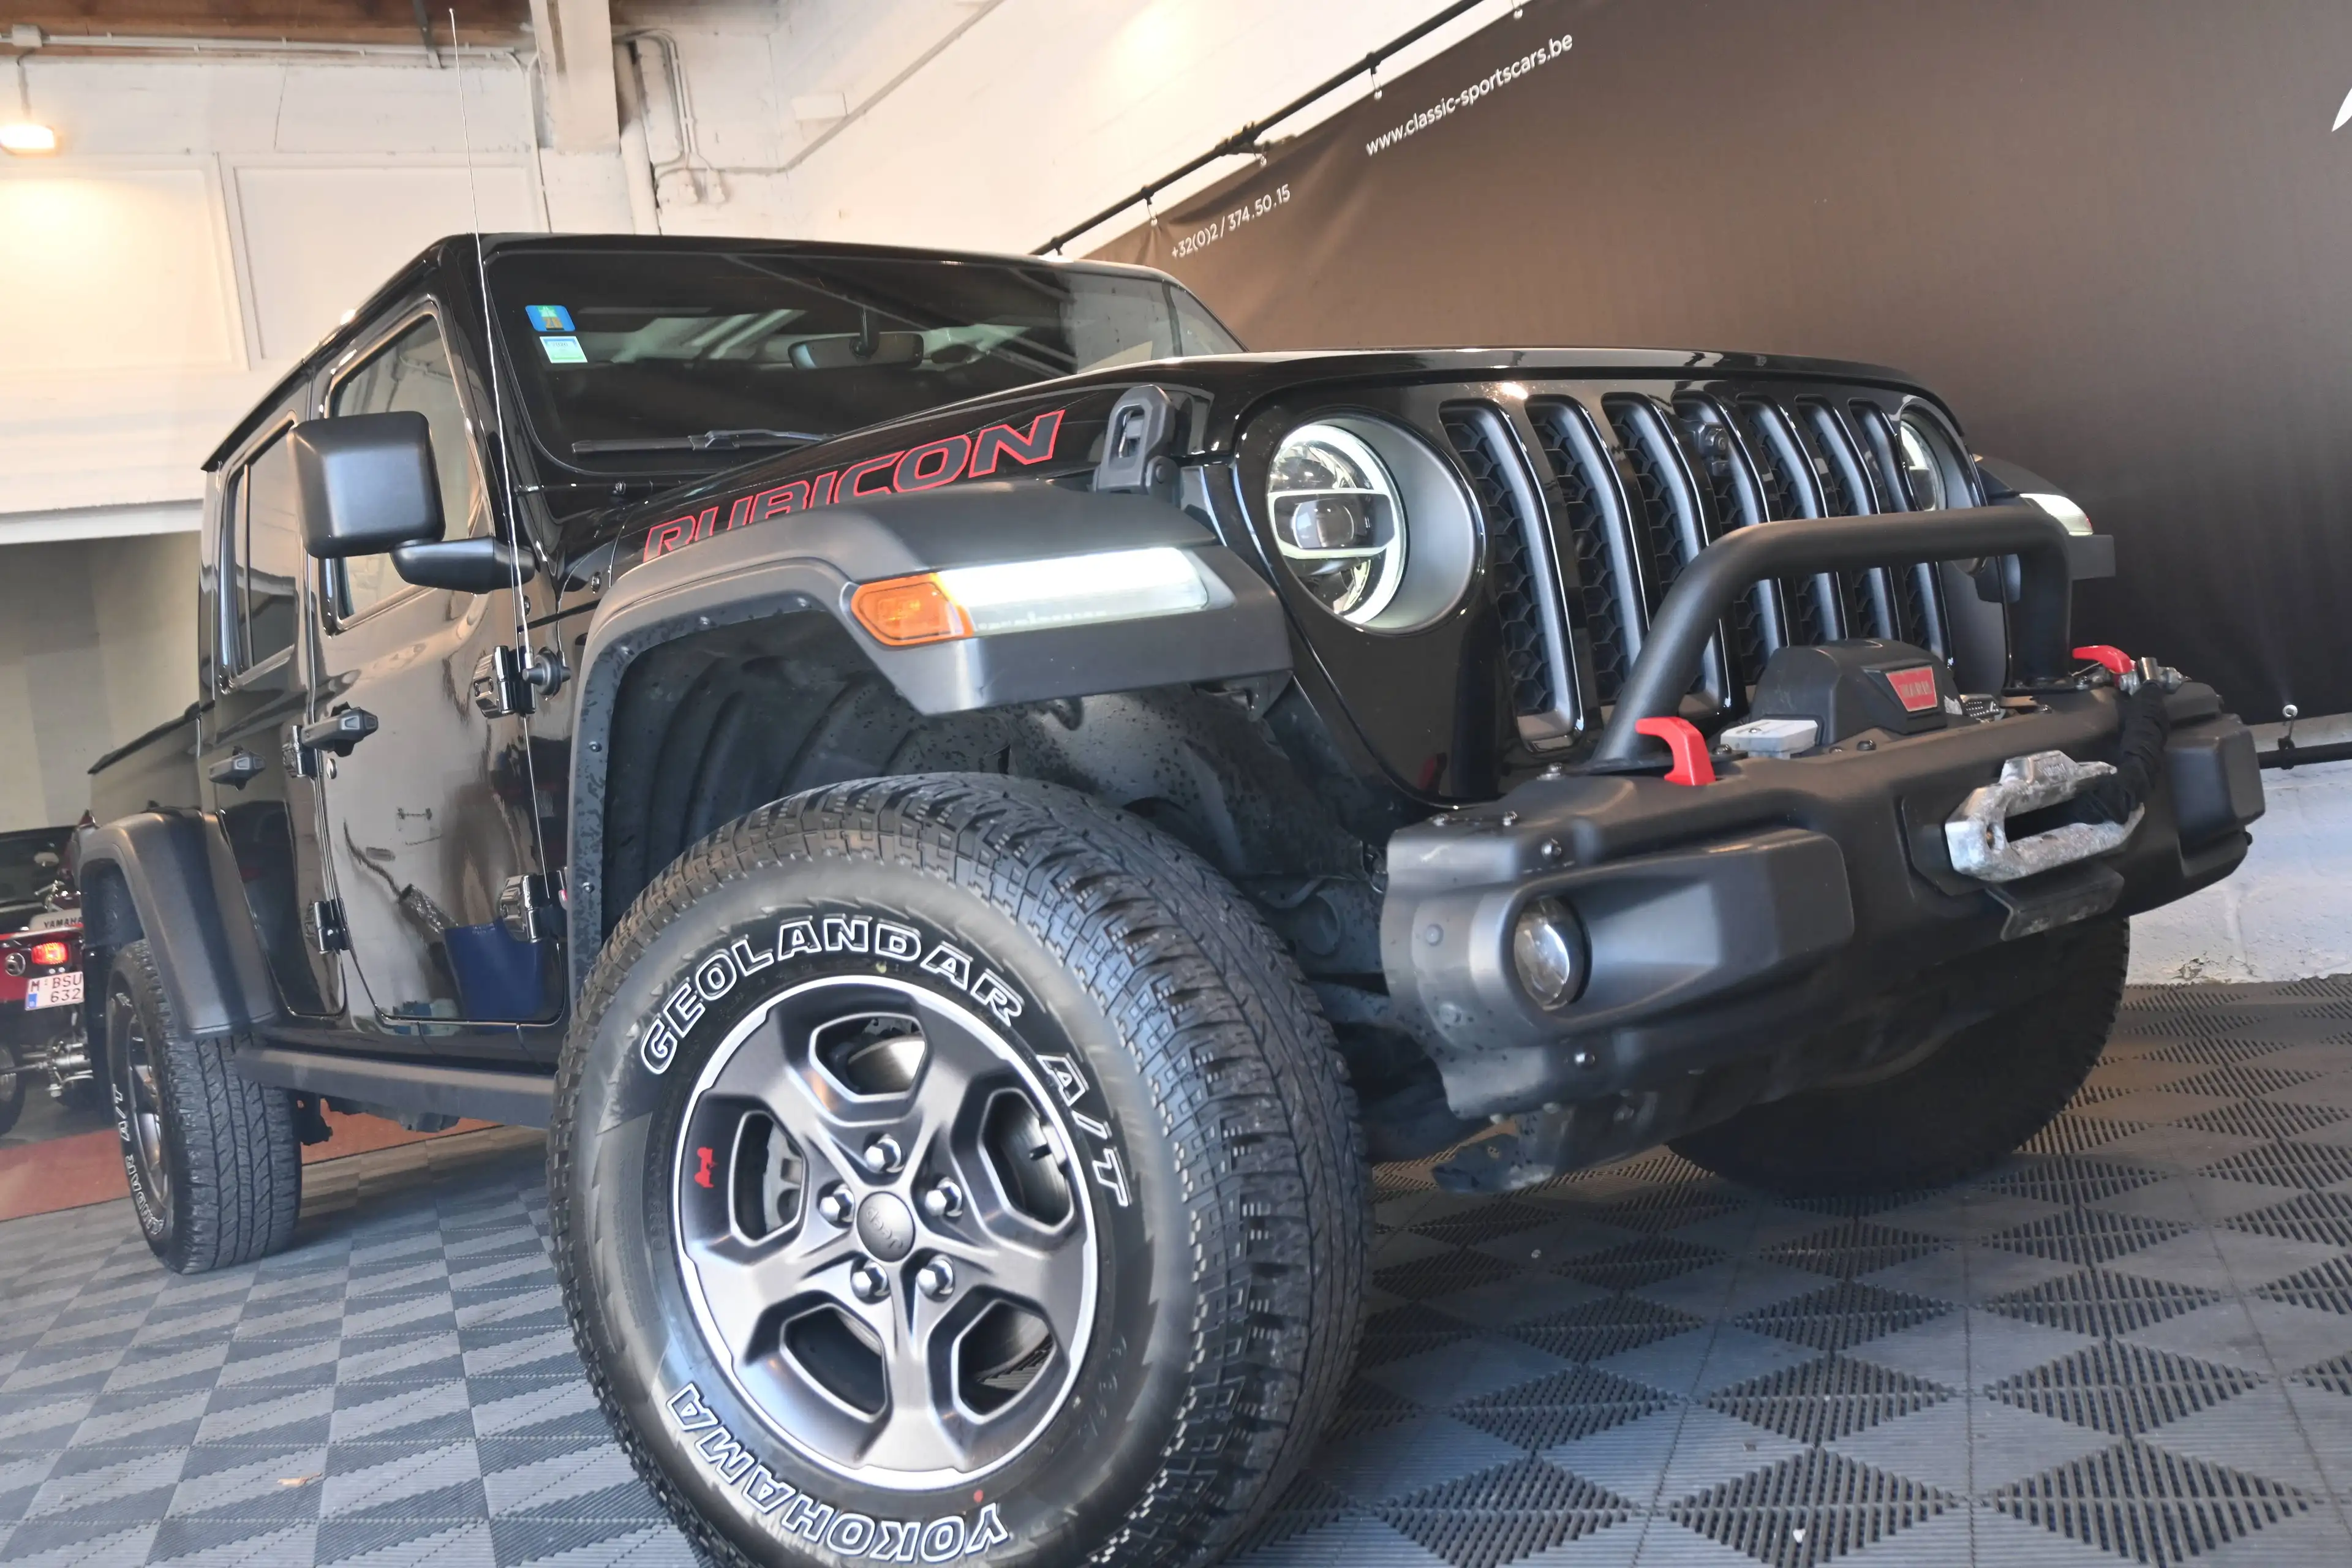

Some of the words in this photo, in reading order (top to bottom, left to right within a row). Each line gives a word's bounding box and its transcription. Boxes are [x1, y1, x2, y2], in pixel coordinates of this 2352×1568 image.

[1366, 34, 1573, 156] www.classic-sportscars.be
[1172, 224, 1218, 258] +32(0)2
[1228, 184, 1291, 232] 374.50.15
[641, 409, 1066, 563] RUBICON
[51, 988, 81, 1003] 632
[53, 974, 82, 988] BSU
[639, 917, 1023, 1074] GEOLANDAR
[1036, 1052, 1129, 1207] A/T
[666, 1382, 1012, 1564] YOKOHAMA
